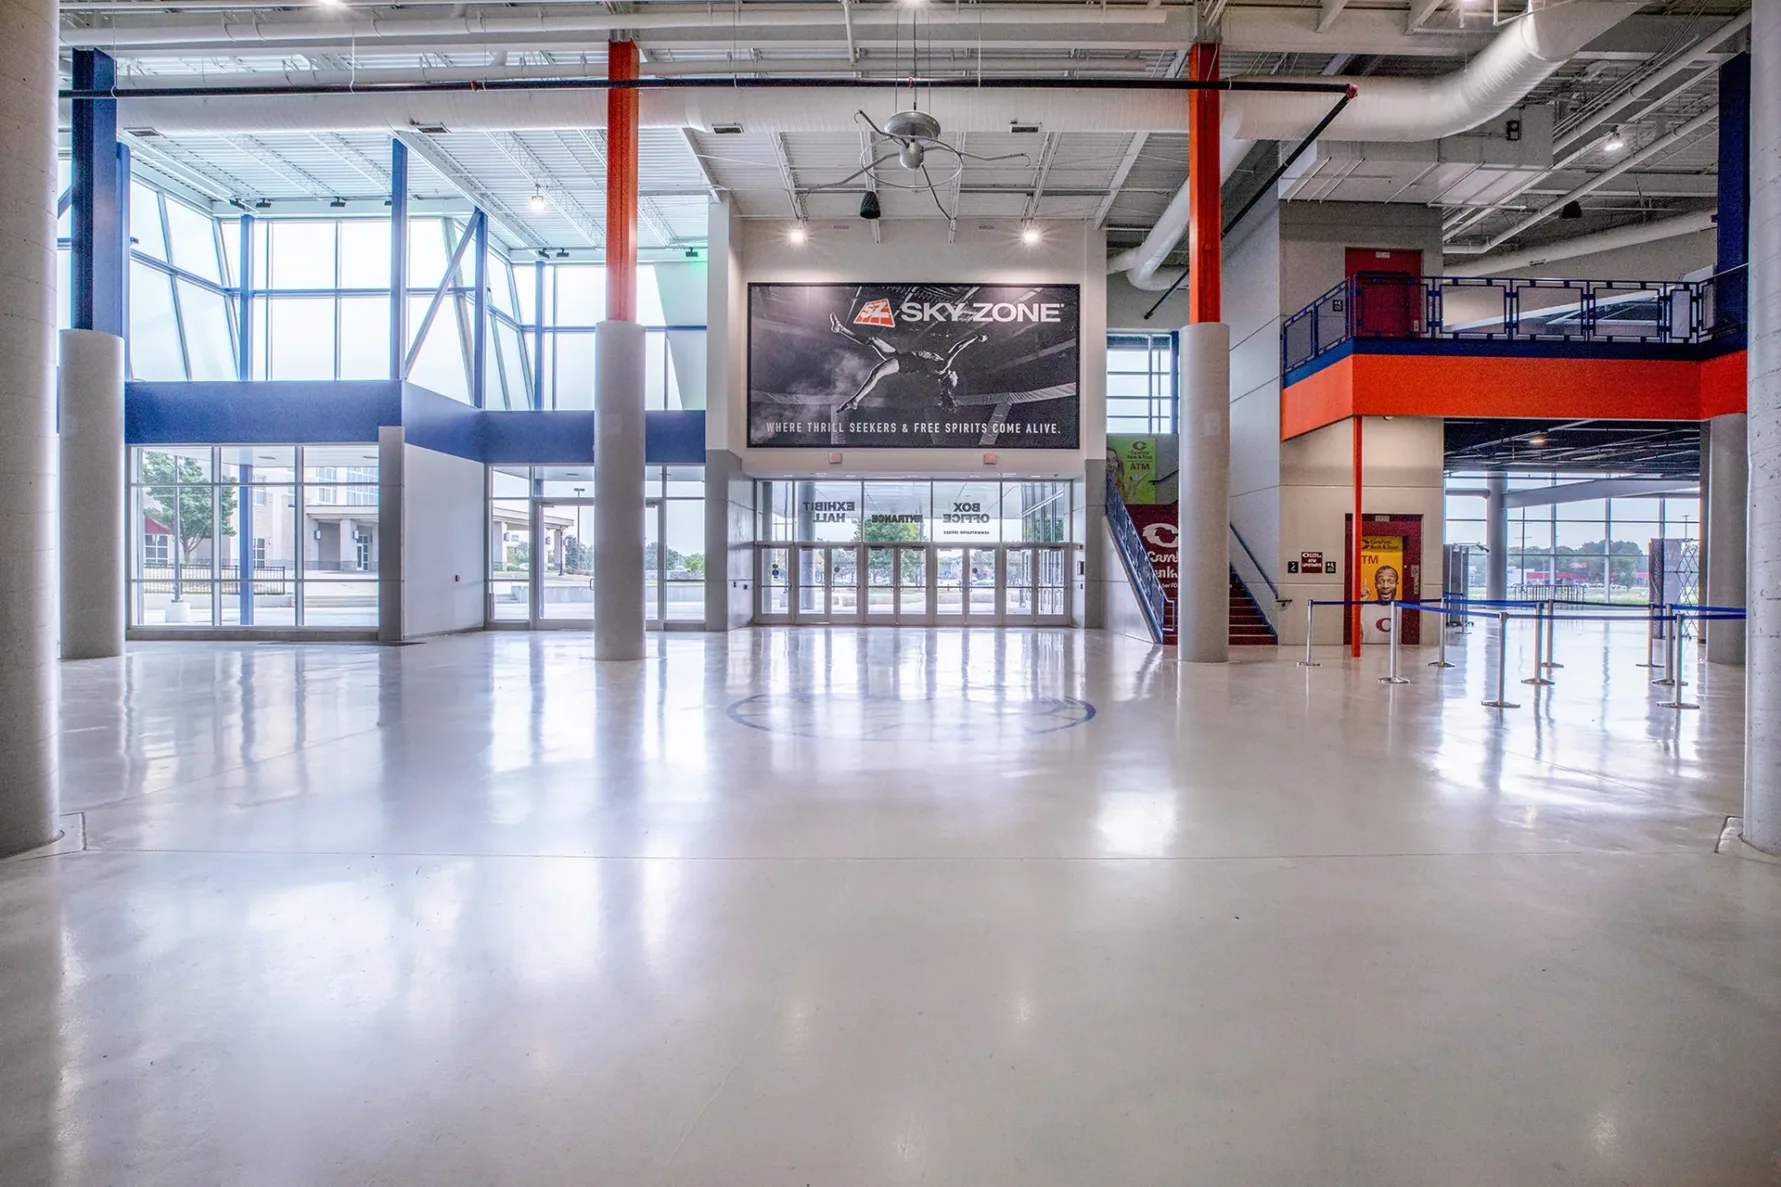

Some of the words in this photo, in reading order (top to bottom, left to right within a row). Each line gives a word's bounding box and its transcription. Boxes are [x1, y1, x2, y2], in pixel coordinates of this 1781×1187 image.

[861, 302, 889, 319] SZ
[901, 302, 966, 322] SKY
[973, 302, 1062, 322] ZONE
[766, 422, 802, 433] WHERE
[807, 422, 844, 433] THRILL
[849, 422, 897, 433] SEEKERS
[902, 423, 909, 433] &
[914, 422, 940, 433] FREE
[944, 422, 987, 433] SPIRITS
[992, 423, 1021, 433] COME
[1025, 423, 1061, 434] ALIVE.
[1361, 555, 1379, 564] TM
